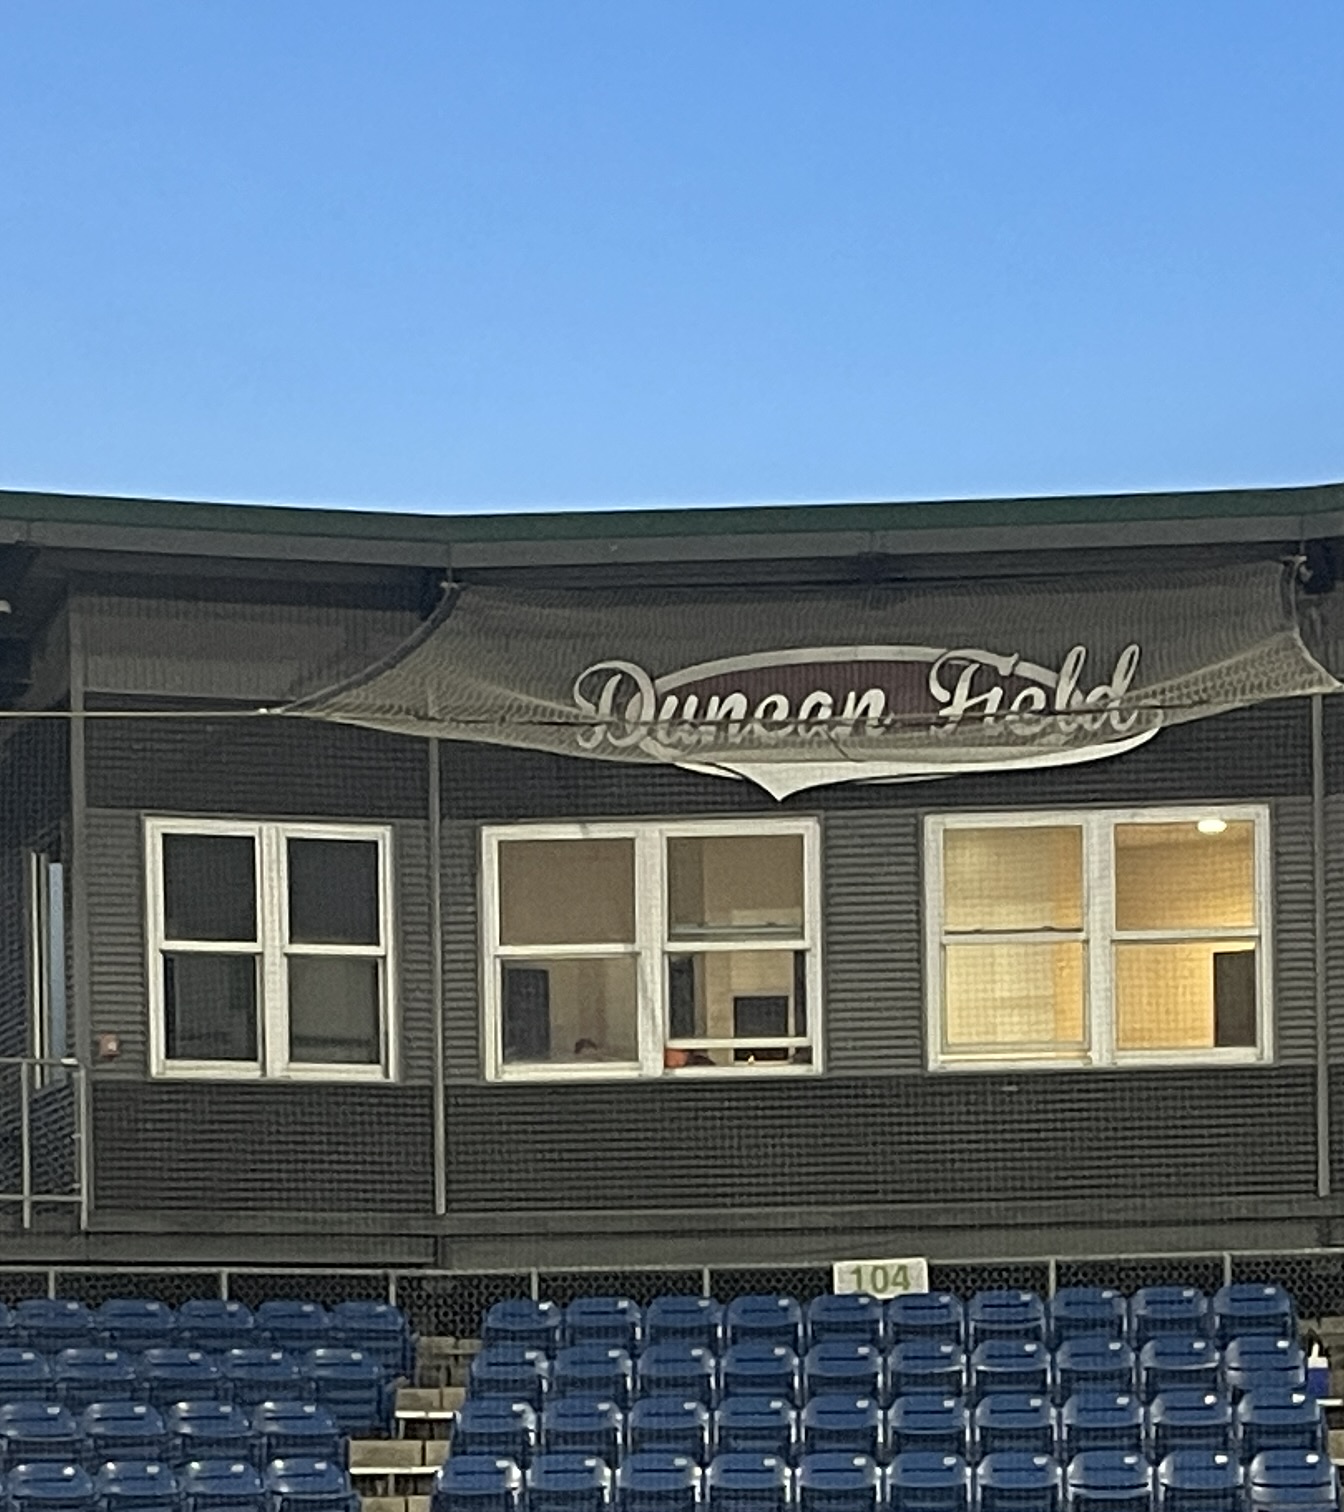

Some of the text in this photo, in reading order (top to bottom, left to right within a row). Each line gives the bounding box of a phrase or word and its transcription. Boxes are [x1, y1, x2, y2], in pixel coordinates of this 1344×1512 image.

[573, 644, 1163, 748] Duncan Field
[850, 1264, 911, 1294] 104
